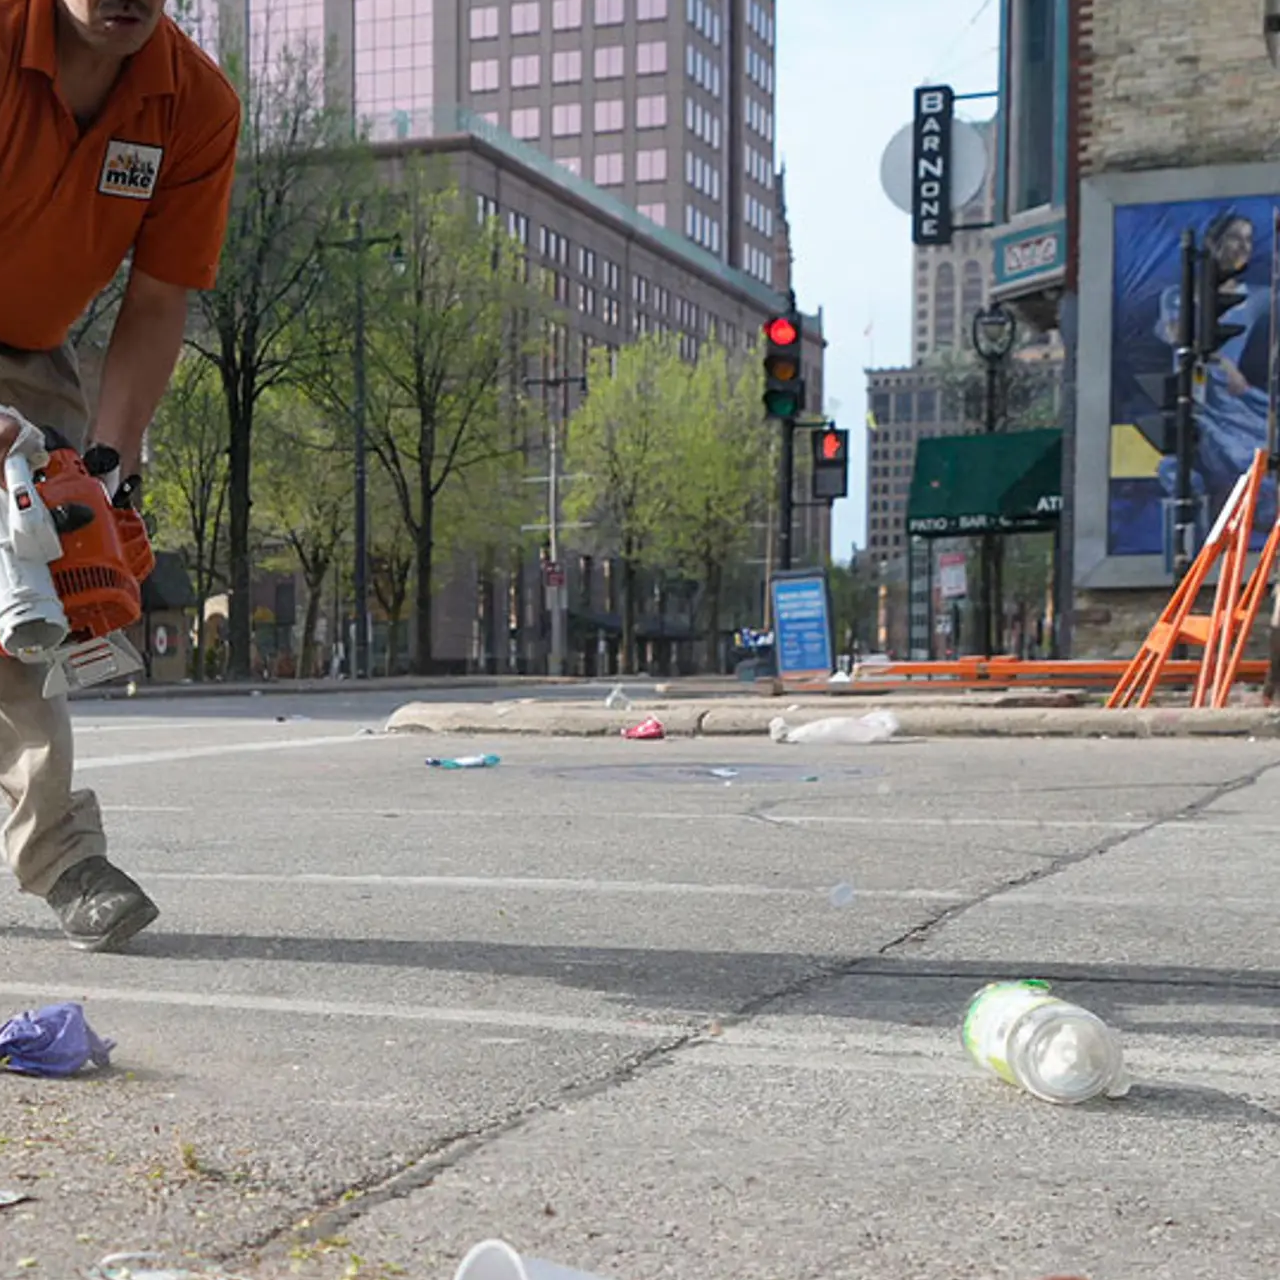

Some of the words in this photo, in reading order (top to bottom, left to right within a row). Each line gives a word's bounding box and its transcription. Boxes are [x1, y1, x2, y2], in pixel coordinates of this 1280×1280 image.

[107, 167, 152, 188] mke
[910, 517, 948, 531] PATIO
[959, 515, 987, 528] BAR
